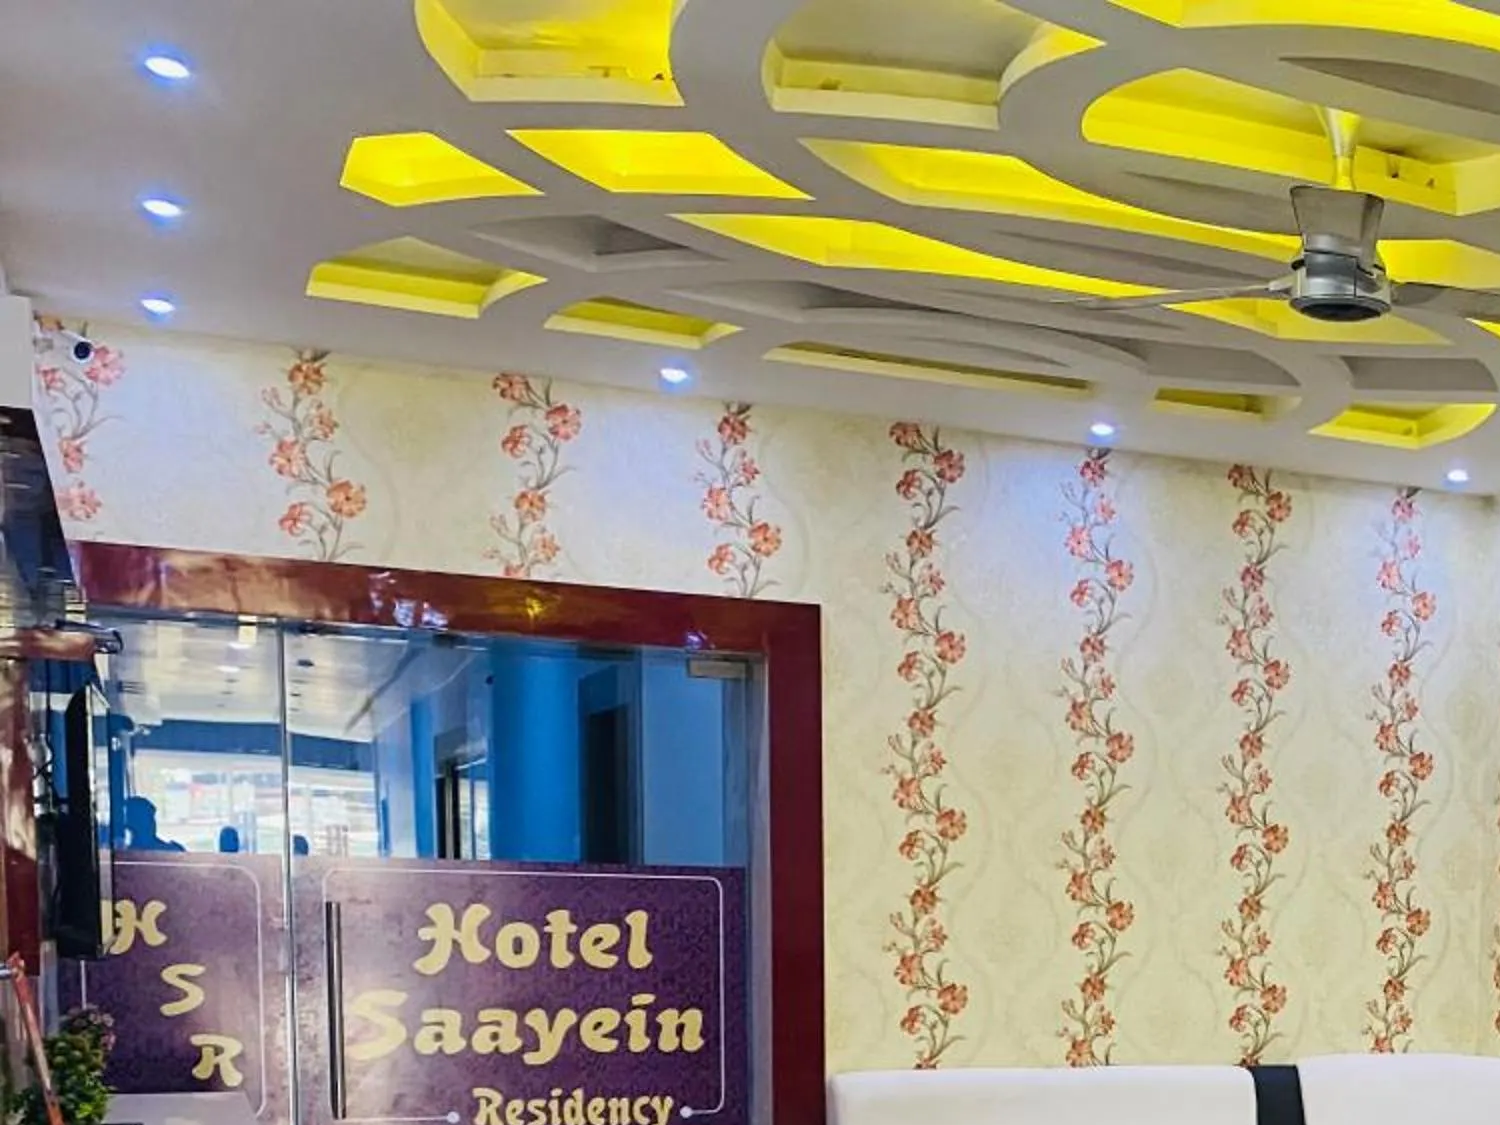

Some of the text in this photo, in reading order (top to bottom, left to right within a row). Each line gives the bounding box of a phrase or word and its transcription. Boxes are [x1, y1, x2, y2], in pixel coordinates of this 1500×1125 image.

[412, 902, 654, 976] Hotel
[159, 963, 207, 1018] S
[344, 988, 705, 1066] Saayein
[189, 1033, 244, 1088] R
